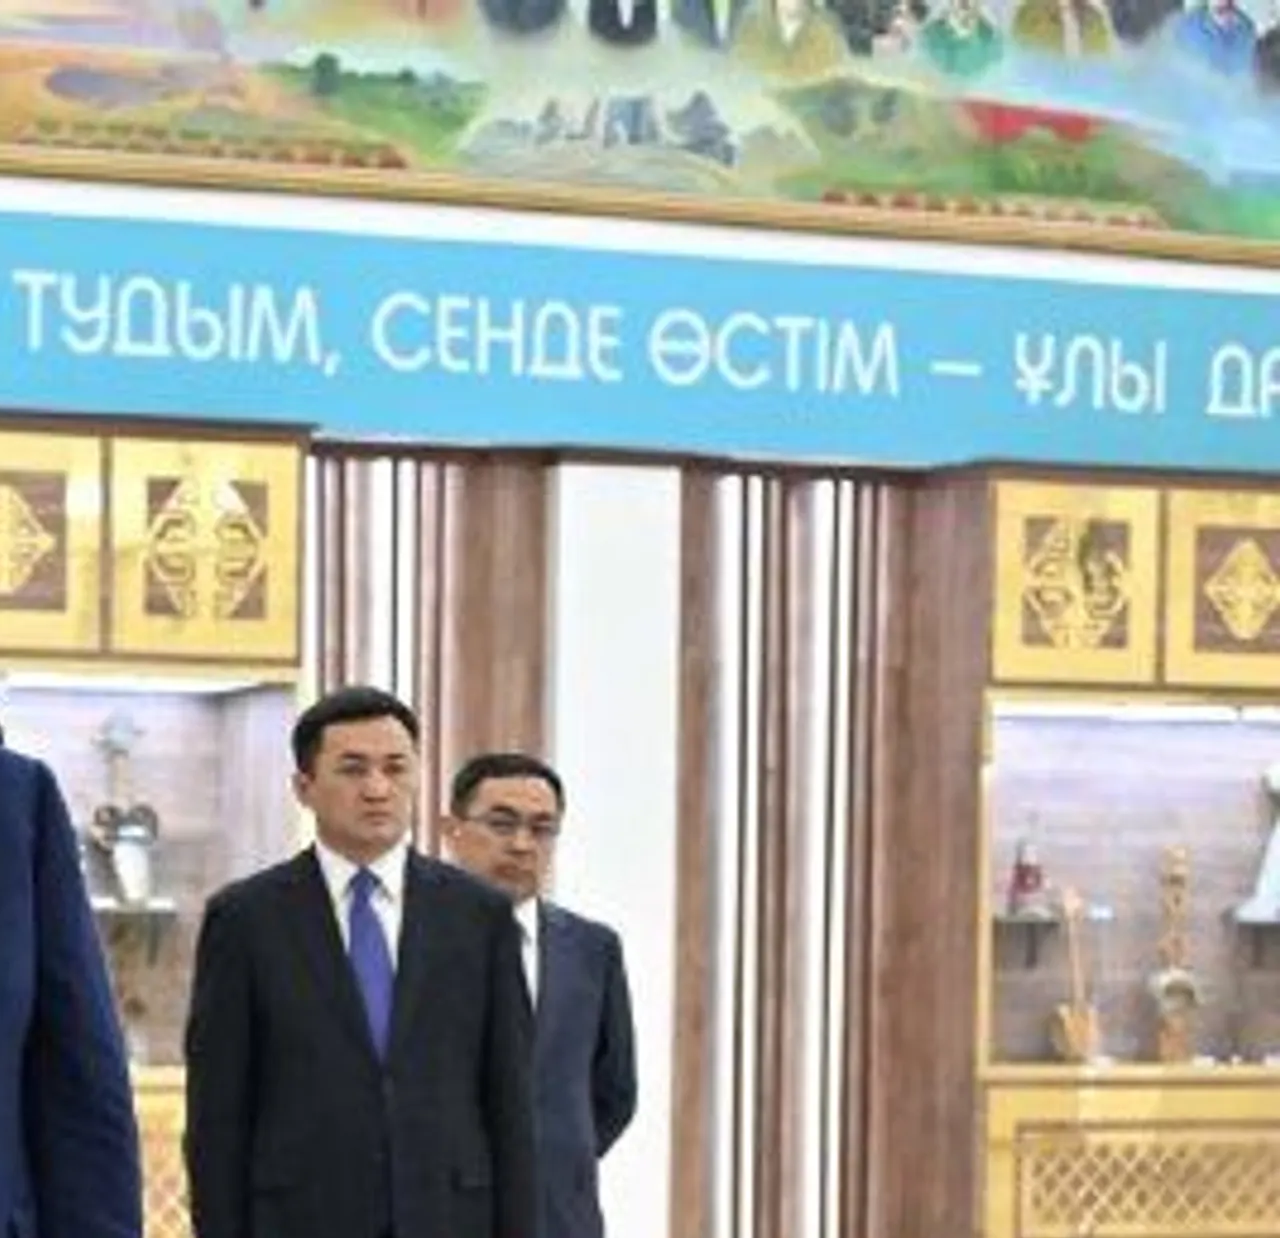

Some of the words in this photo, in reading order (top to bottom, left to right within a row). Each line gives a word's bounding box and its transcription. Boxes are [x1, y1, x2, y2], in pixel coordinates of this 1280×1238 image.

[12, 269, 342, 376] ТУДЫМ,
[371, 292, 623, 382] СЕНДЕ
[649, 309, 899, 398] ӨСТІМ
[1014, 332, 1166, 414] ҰЛЫ
